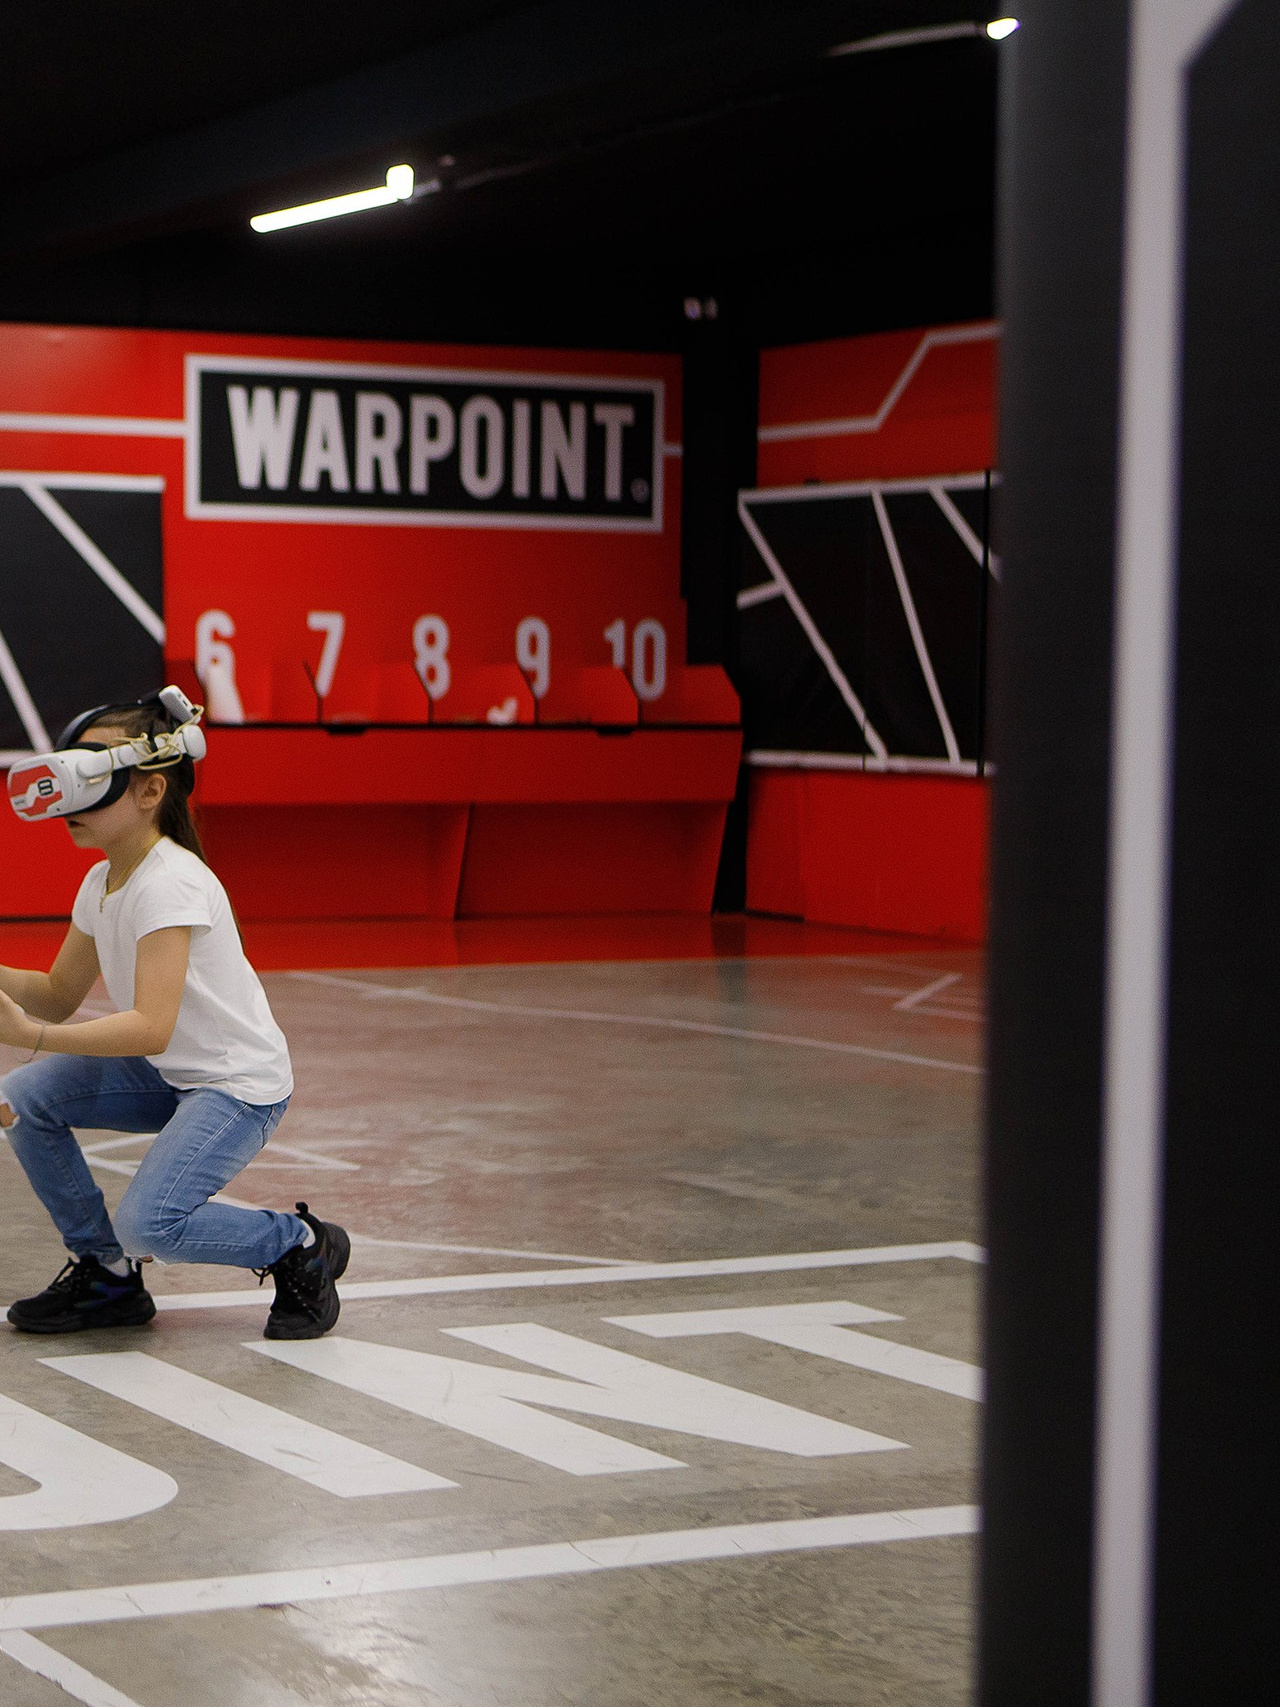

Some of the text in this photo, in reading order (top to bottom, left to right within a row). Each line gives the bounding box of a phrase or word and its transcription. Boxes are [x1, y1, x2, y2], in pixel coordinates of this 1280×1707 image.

[226, 383, 635, 501] WARPOINT
[307, 611, 345, 698] 7
[412, 615, 451, 700] 8
[516, 616, 550, 700] 9
[604, 617, 667, 702] 10
[37, 779, 54, 796] 8
